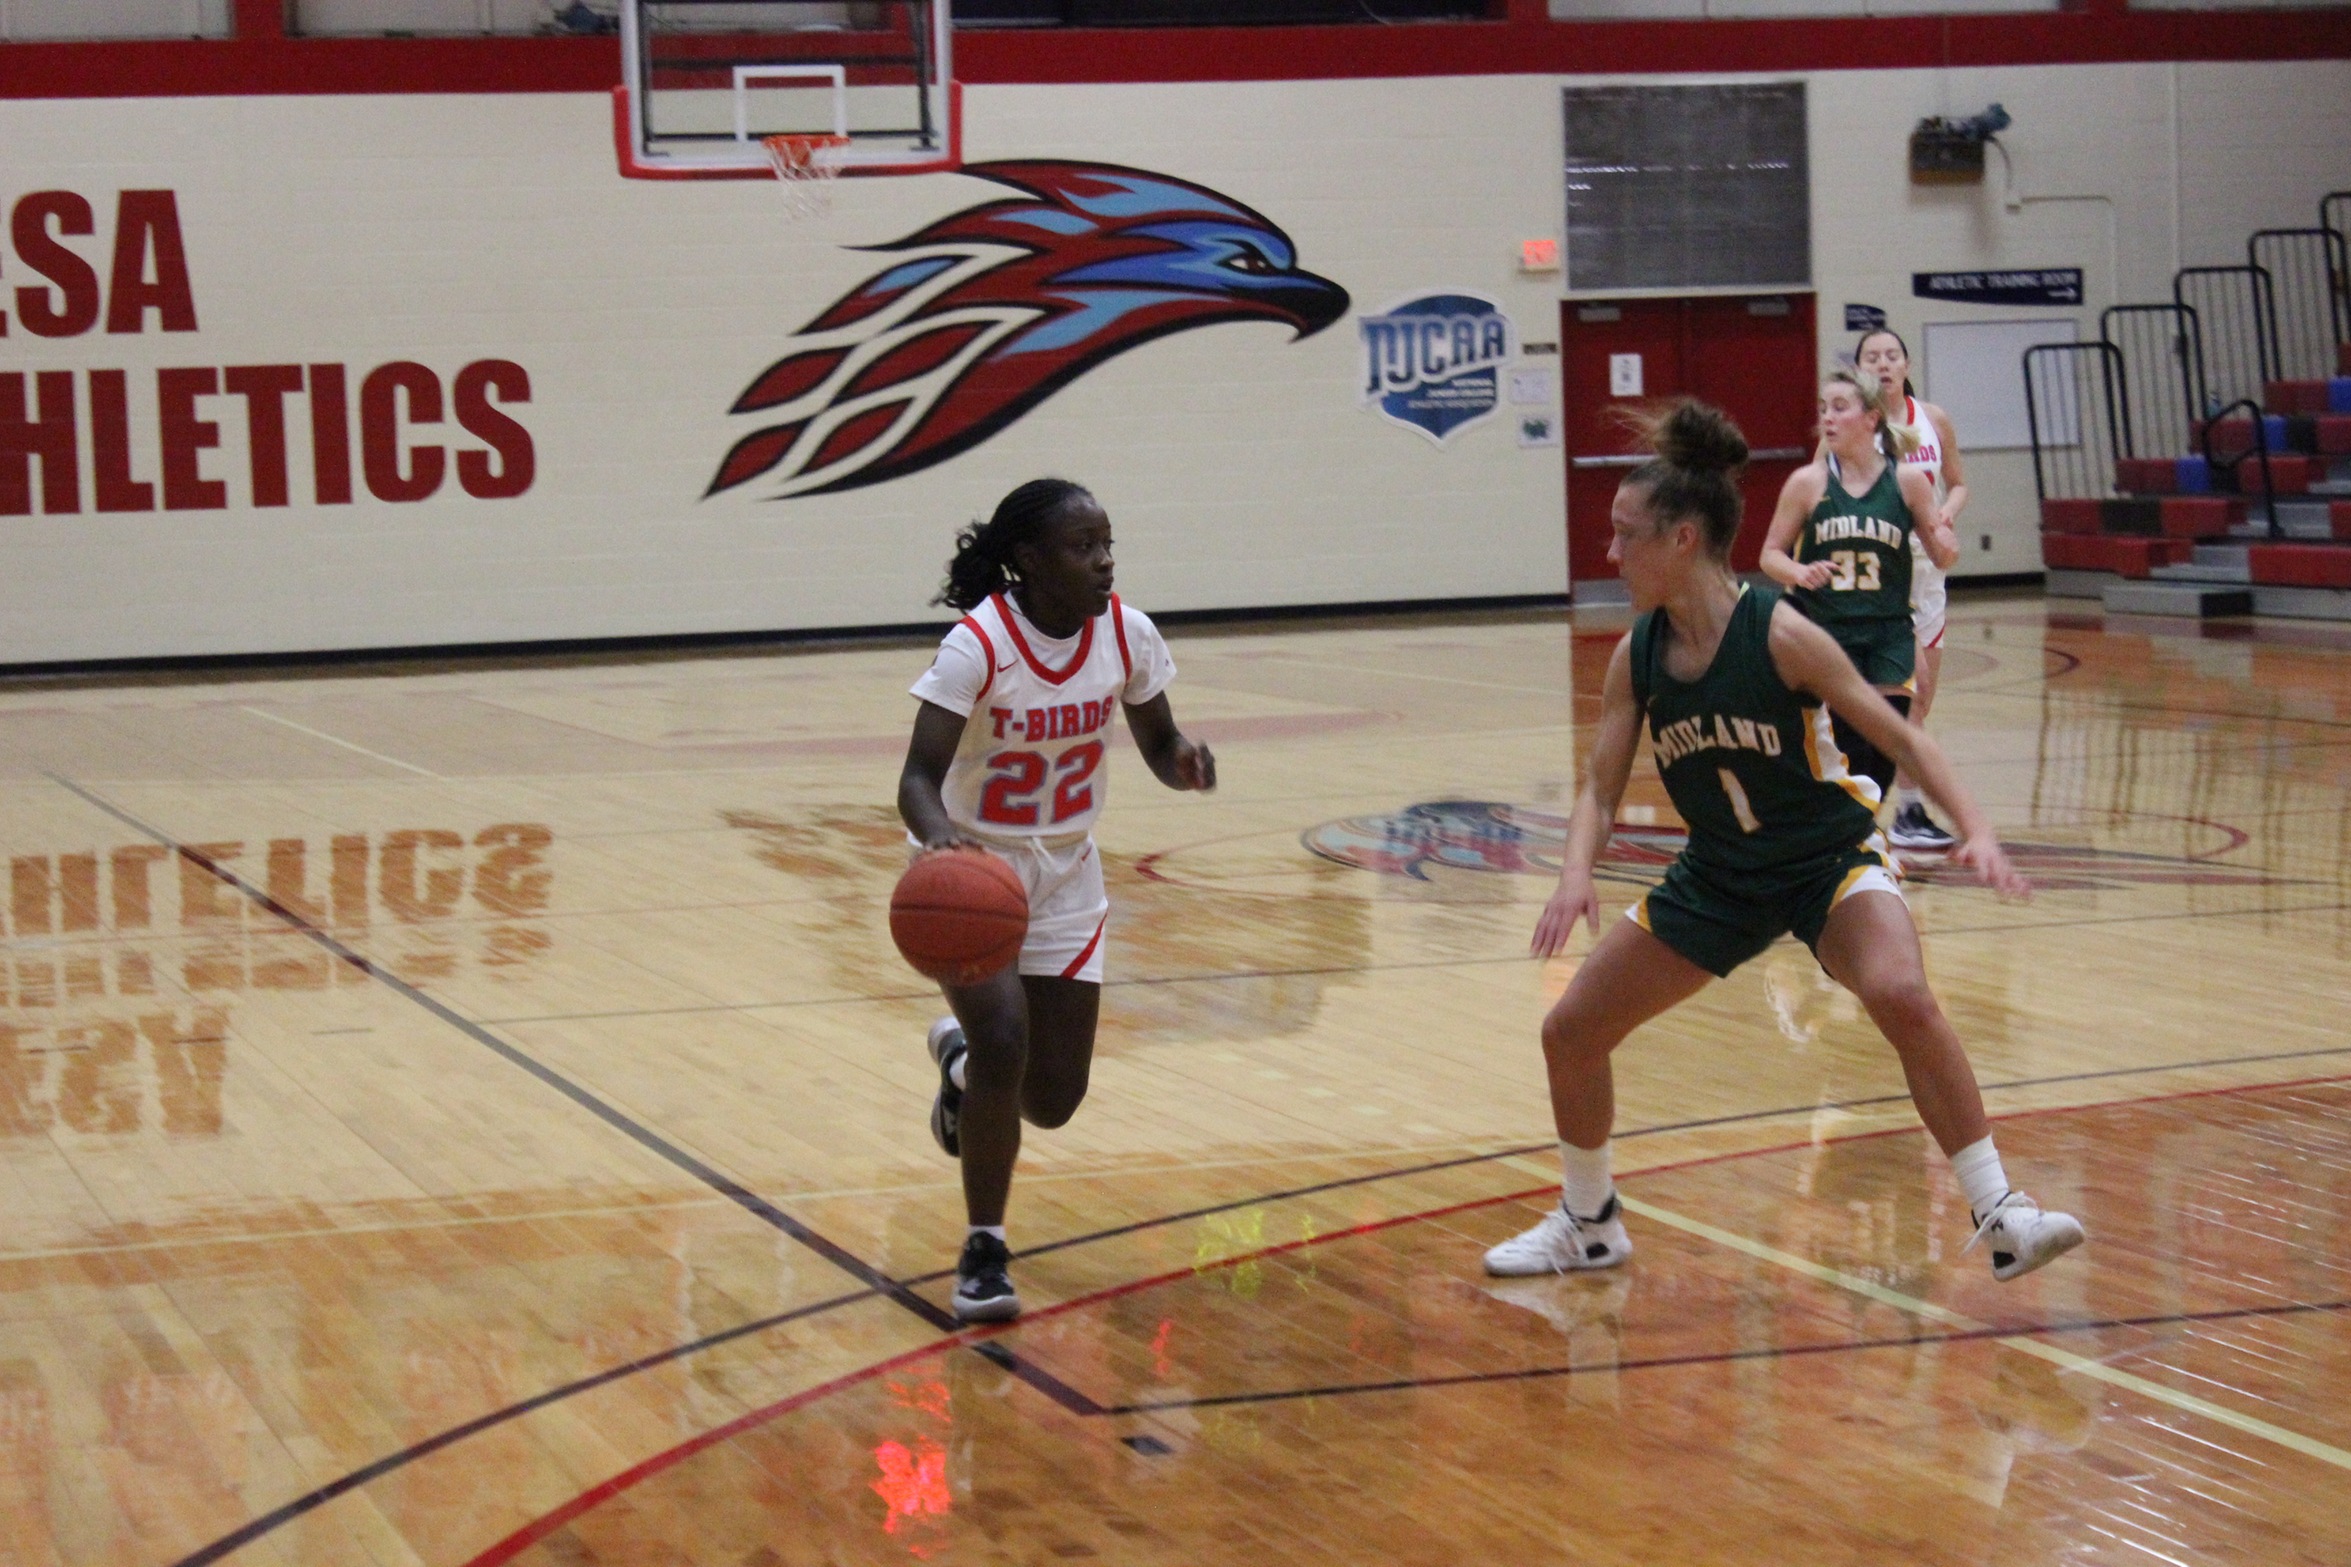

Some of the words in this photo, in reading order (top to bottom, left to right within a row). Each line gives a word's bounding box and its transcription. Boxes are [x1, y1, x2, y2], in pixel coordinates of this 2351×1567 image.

[0, 189, 199, 338] SA
[1362, 317, 1507, 396] NJCAA
[1814, 515, 1902, 550] MIDLAND
[1831, 550, 1881, 591] 33
[989, 695, 1113, 742] T-BIRDS
[1653, 713, 1783, 769] MIDLAND
[977, 739, 1105, 826] 22
[1716, 765, 1763, 834] 1
